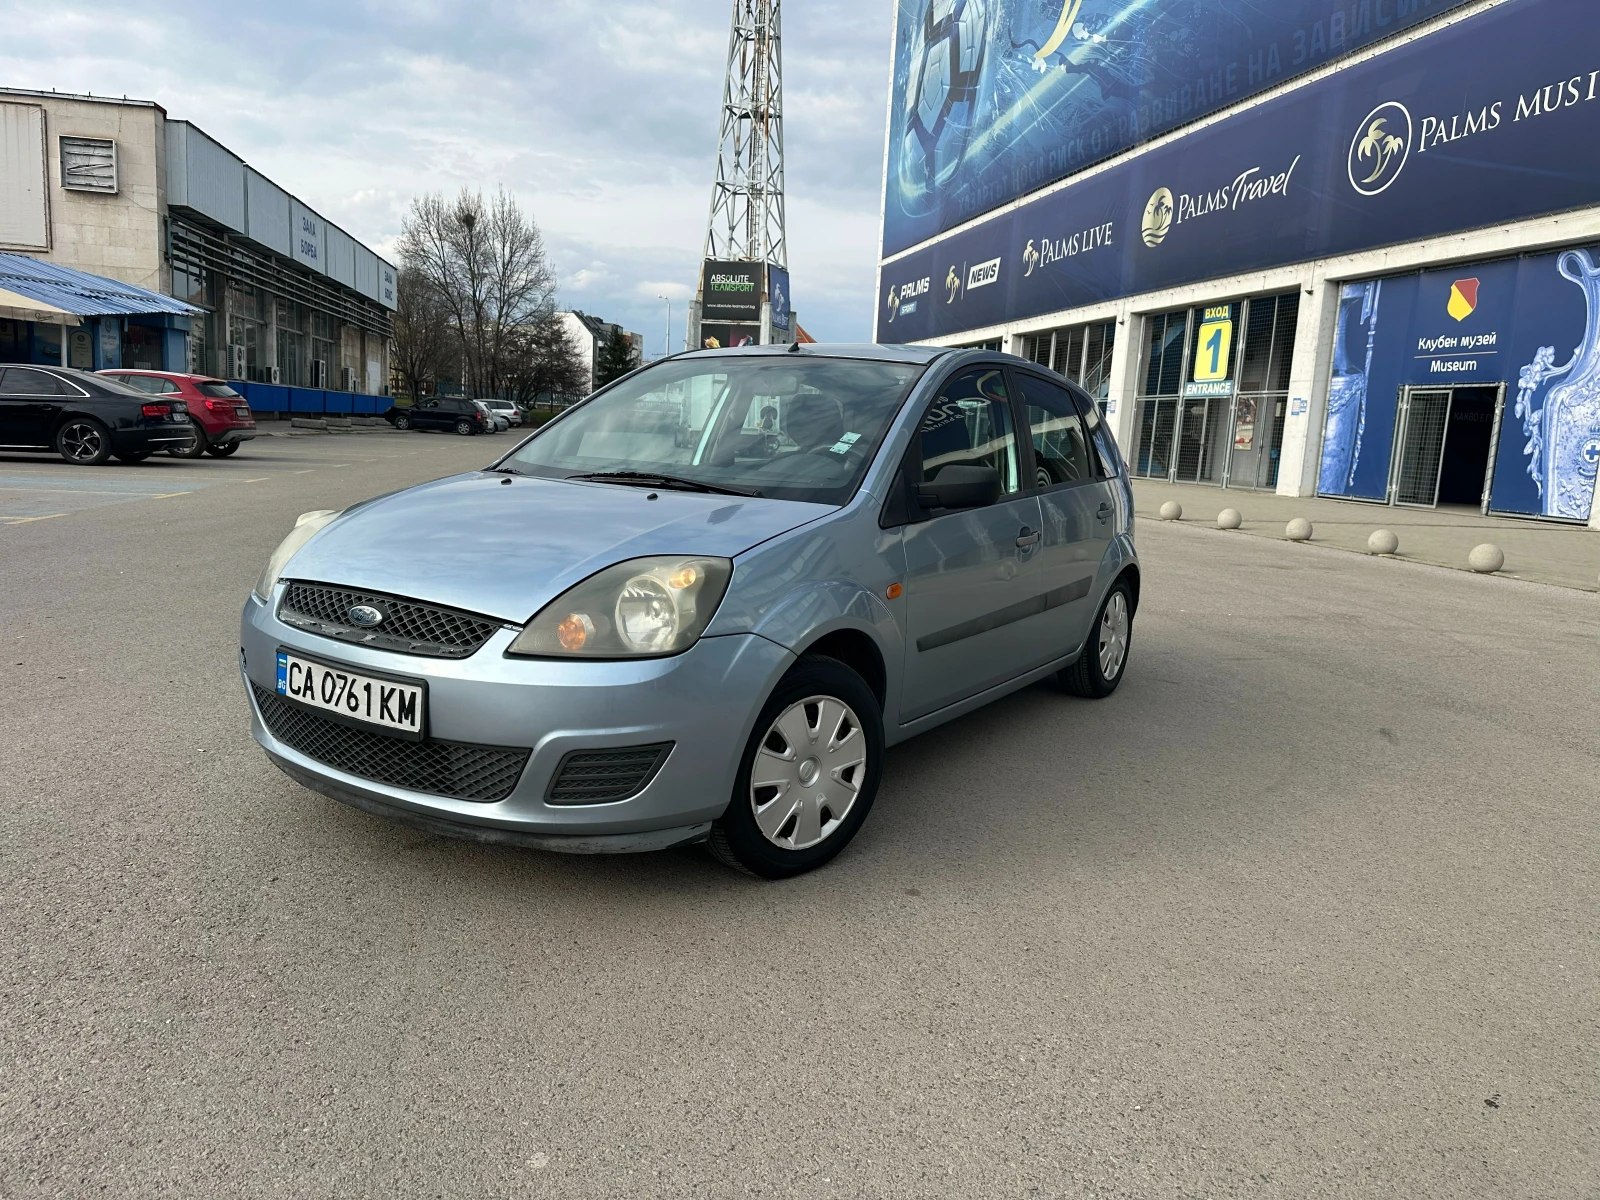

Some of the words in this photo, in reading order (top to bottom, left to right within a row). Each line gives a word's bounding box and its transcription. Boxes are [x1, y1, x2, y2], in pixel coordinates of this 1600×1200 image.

[1012, 156, 1045, 192] НОСИ
[1048, 136, 1085, 174] РИСК
[1118, 61, 1239, 146] РАЗВИВАНЕ
[1249, 42, 1282, 84] НА
[1417, 101, 1502, 153] PALMS
[1176, 186, 1230, 224] PALMS
[1231, 154, 1301, 211] Travel
[302, 216, 317, 238] ЗАЛА
[300, 238, 318, 260] БОРБА
[1039, 233, 1080, 268] PALMS
[1081, 222, 1113, 252] LIVE
[710, 274, 750, 283] ABSOLUTE
[971, 263, 998, 286] NEWS
[710, 283, 754, 292] TEAMSPORT
[900, 276, 931, 300] PALMS
[901, 303, 916, 314] SPORT
[1204, 305, 1229, 320] ВХОД
[1206, 328, 1223, 374] 1
[1417, 335, 1458, 352] Клубен
[1460, 331, 1497, 349] музей
[1430, 360, 1478, 373] Museum
[1186, 382, 1232, 395] ENTRANCE
[278, 679, 286, 690] BG
[289, 661, 315, 700] CA
[321, 670, 372, 717] 0761
[379, 685, 417, 727] KM
